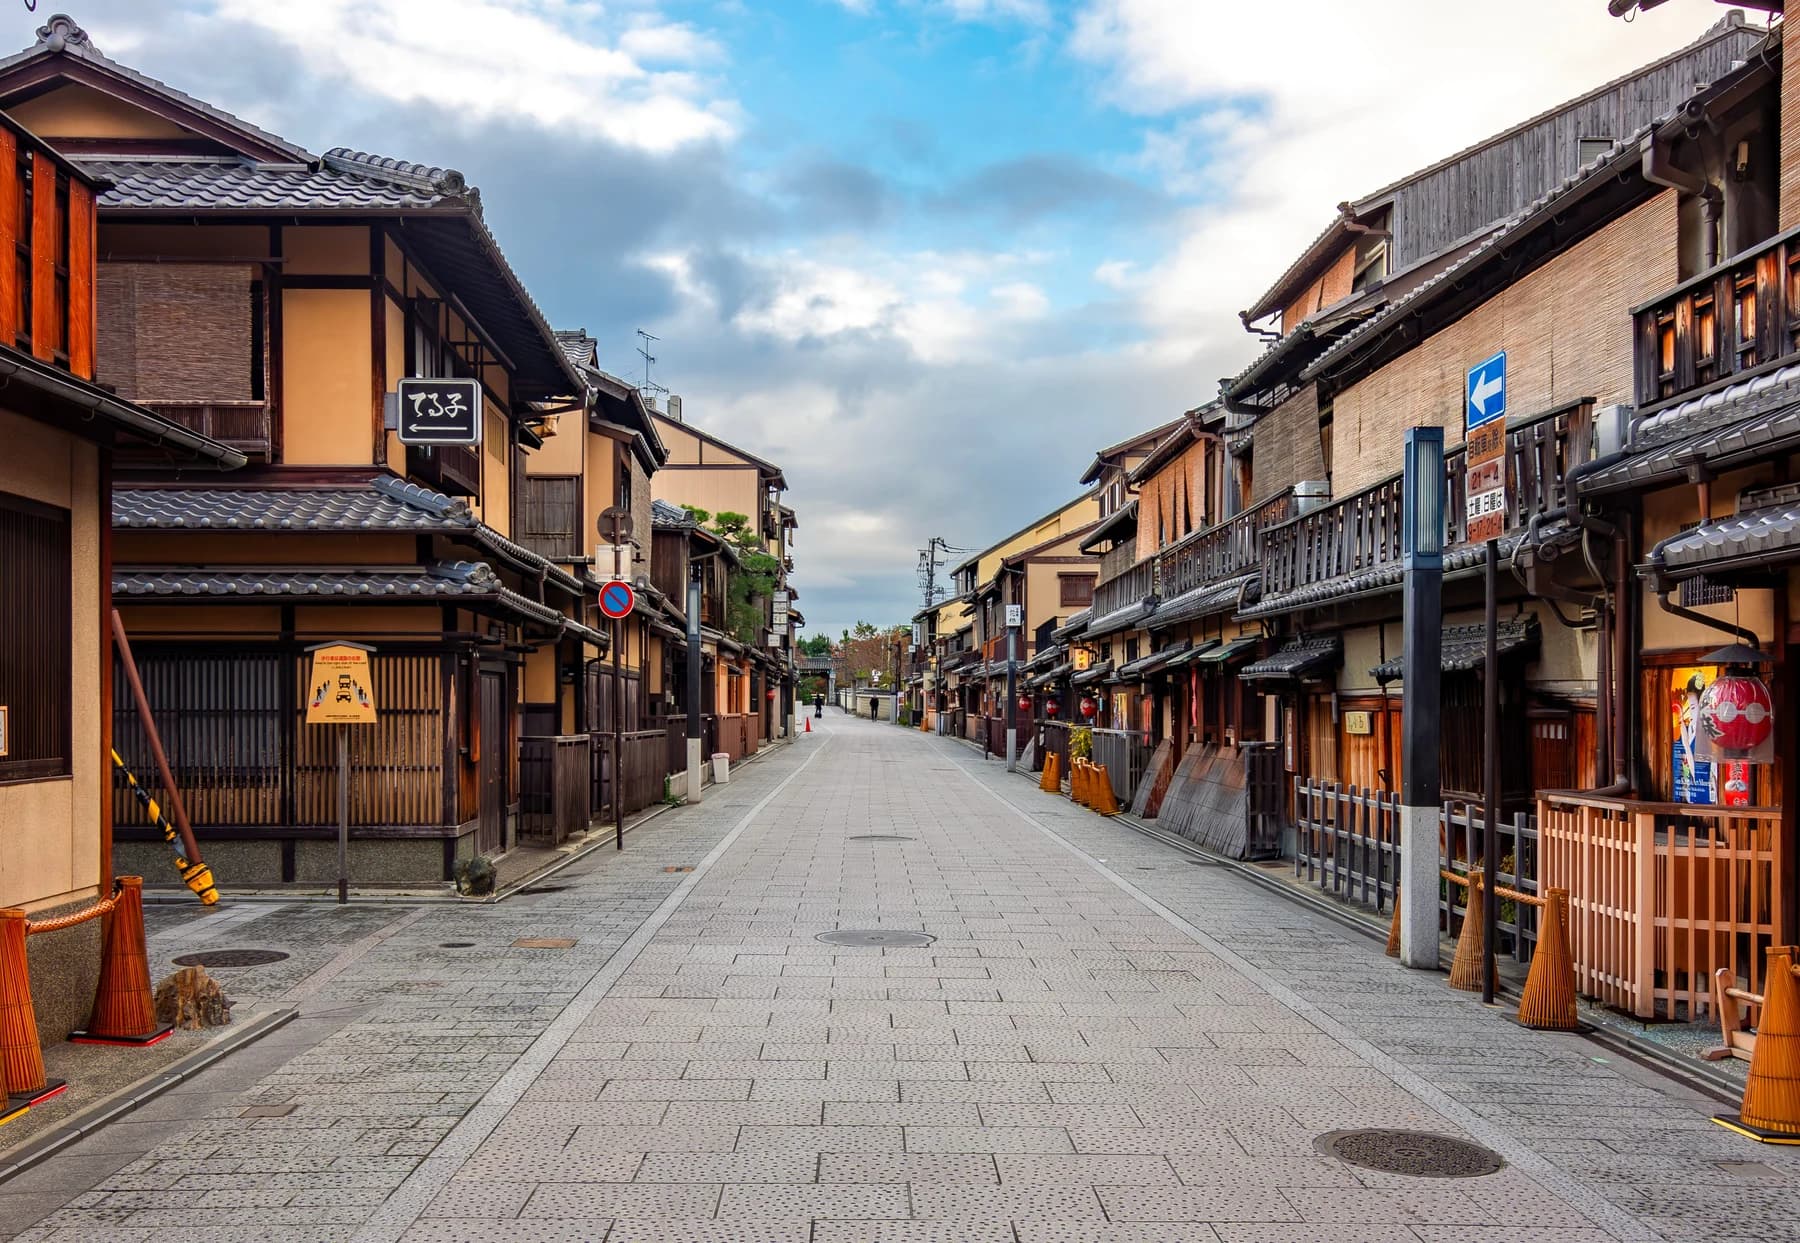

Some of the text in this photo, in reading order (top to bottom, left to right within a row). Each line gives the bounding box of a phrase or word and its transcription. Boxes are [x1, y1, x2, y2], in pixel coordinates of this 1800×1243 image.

[408, 392, 468, 418] てる子
[1469, 428, 1504, 460] 自転車を除く
